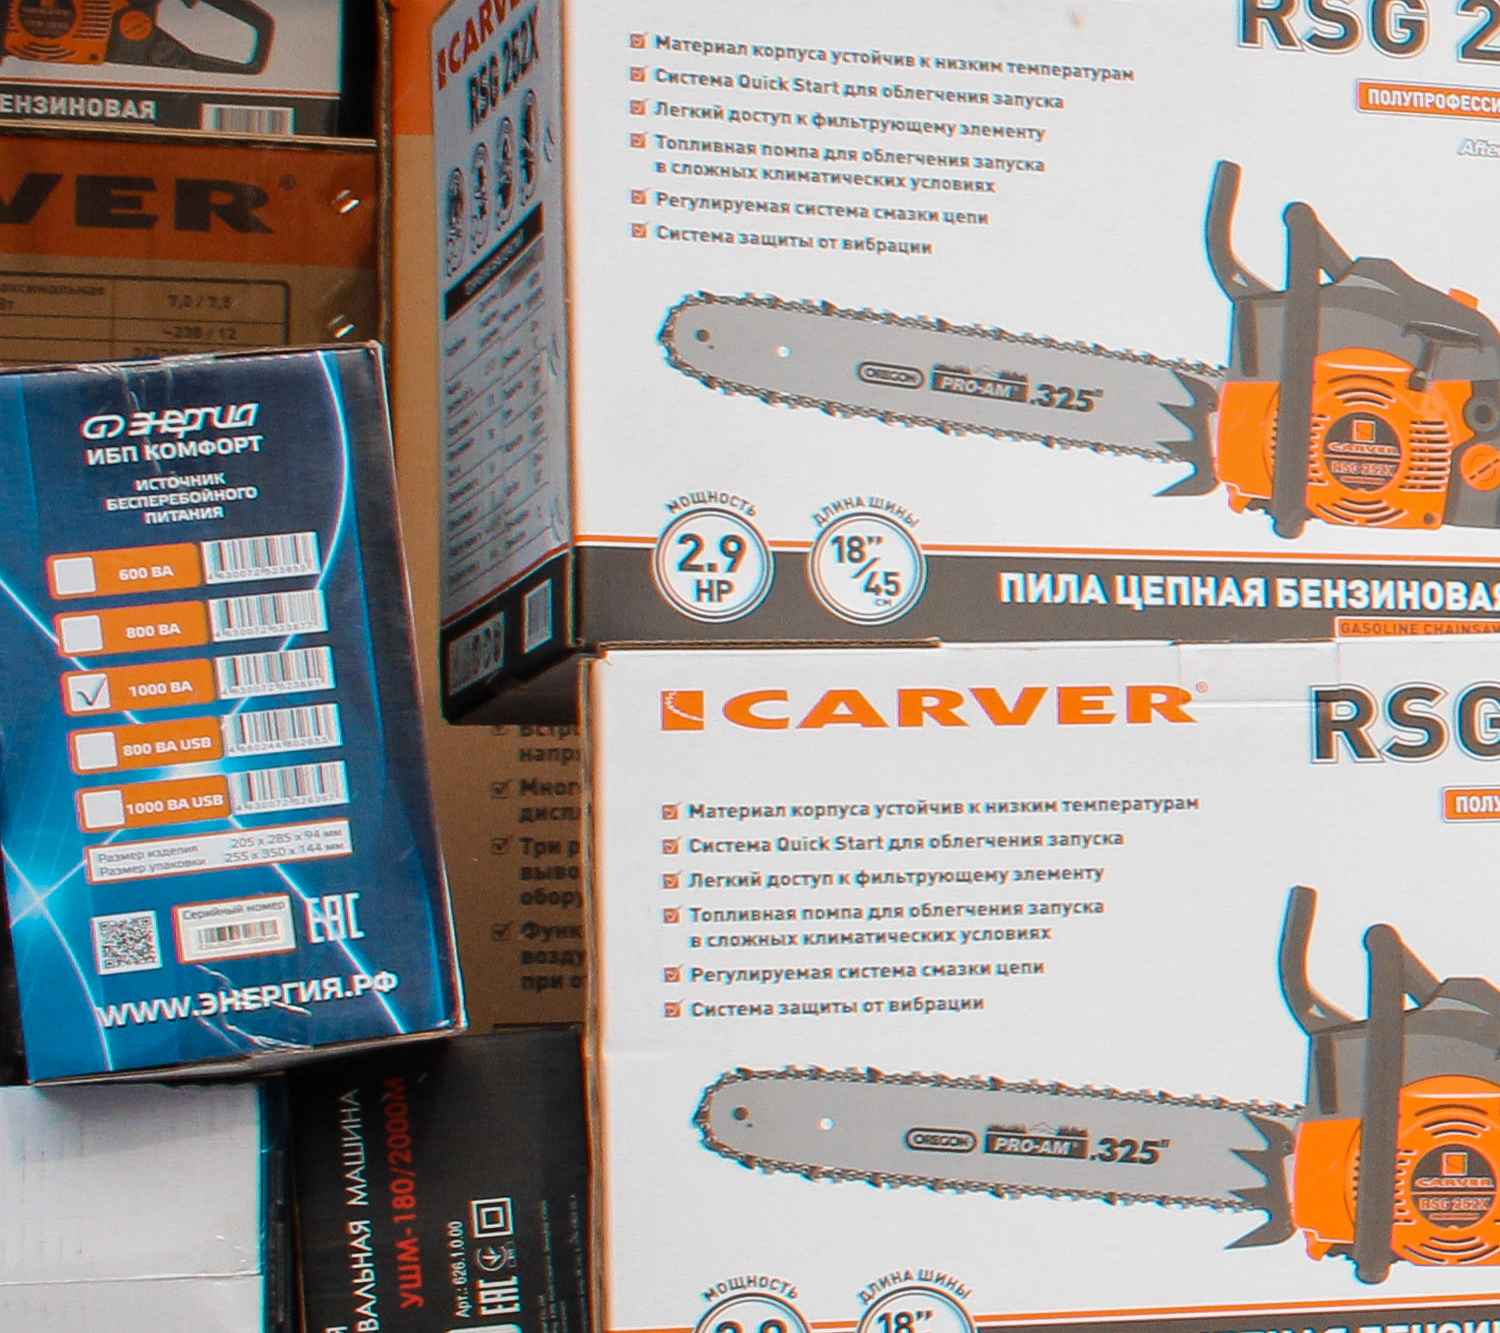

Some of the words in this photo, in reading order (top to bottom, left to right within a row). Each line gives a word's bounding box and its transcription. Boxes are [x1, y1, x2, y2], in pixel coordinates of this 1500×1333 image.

[86, 446, 139, 467] ИБП
[143, 436, 264, 462] КОМФОРТ
[134, 472, 226, 492] ИСТОЧНИК
[105, 485, 259, 512] БЕСПЕРЕБОЙНОГО
[143, 505, 225, 525] ПИТАНИЯ
[118, 566, 145, 582] 600
[146, 565, 175, 580] ВА
[1000, 572, 1107, 607] ПИЛА
[1113, 574, 1269, 612] ЦЕПНАЯ
[125, 624, 152, 640] 800
[153, 622, 181, 637] ВА
[1339, 621, 1419, 637] GASOLINE
[128, 682, 164, 698] 1000
[164, 680, 193, 695] ВА
[721, 685, 1199, 729] CARVER
[123, 740, 151, 757] 800
[152, 739, 176, 754] ВА
[178, 734, 213, 752] USB
[125, 798, 160, 816] 1000
[161, 798, 186, 813] ВА
[188, 793, 225, 811] USB
[685, 803, 787, 822] Материал
[789, 804, 871, 821] корпуса
[873, 799, 966, 819] устойчив
[967, 802, 981, 814] к
[983, 801, 1059, 814] низким
[1060, 798, 1200, 815] температурам
[685, 838, 773, 854] Система
[774, 836, 831, 853] Quick
[832, 835, 885, 852] Start
[885, 837, 925, 852] для
[927, 833, 1045, 850] облегчения
[1046, 833, 1125, 849] запуска
[520, 866, 581, 881] выво
[686, 871, 763, 889] Легкий
[764, 873, 835, 890] доступ
[836, 873, 851, 885] к
[852, 869, 1010, 889] фильтрующему
[1012, 868, 1105, 883] элементу
[687, 906, 798, 923] Топливная
[799, 907, 865, 921] помпа
[865, 906, 905, 921] для
[907, 902, 1025, 918] облегчения
[1027, 901, 1105, 918] запуска
[520, 921, 582, 940] Функ
[687, 936, 703, 949] в
[704, 933, 799, 948] сложных
[801, 930, 957, 946] климатических
[959, 928, 1052, 946] условиях
[687, 967, 834, 986] Регулируемая
[835, 965, 918, 980] система
[919, 963, 993, 978] смазки
[994, 962, 1046, 977] цепи
[97, 969, 400, 1029] WWW.ЭНЕРГИЯ.РФ
[688, 1001, 775, 1018] Система
[777, 1001, 859, 1016] защиты
[861, 1000, 885, 1013] от
[886, 996, 985, 1015] вибрации
[338, 1088, 370, 1207] МАШИНА
[994, 1137, 1071, 1155] PRO-AM
[702, 1275, 802, 1302] МОЩНОСТЬ
[858, 1268, 916, 1306] ДЛИНА
[918, 1268, 975, 1300] ШИНЫ
